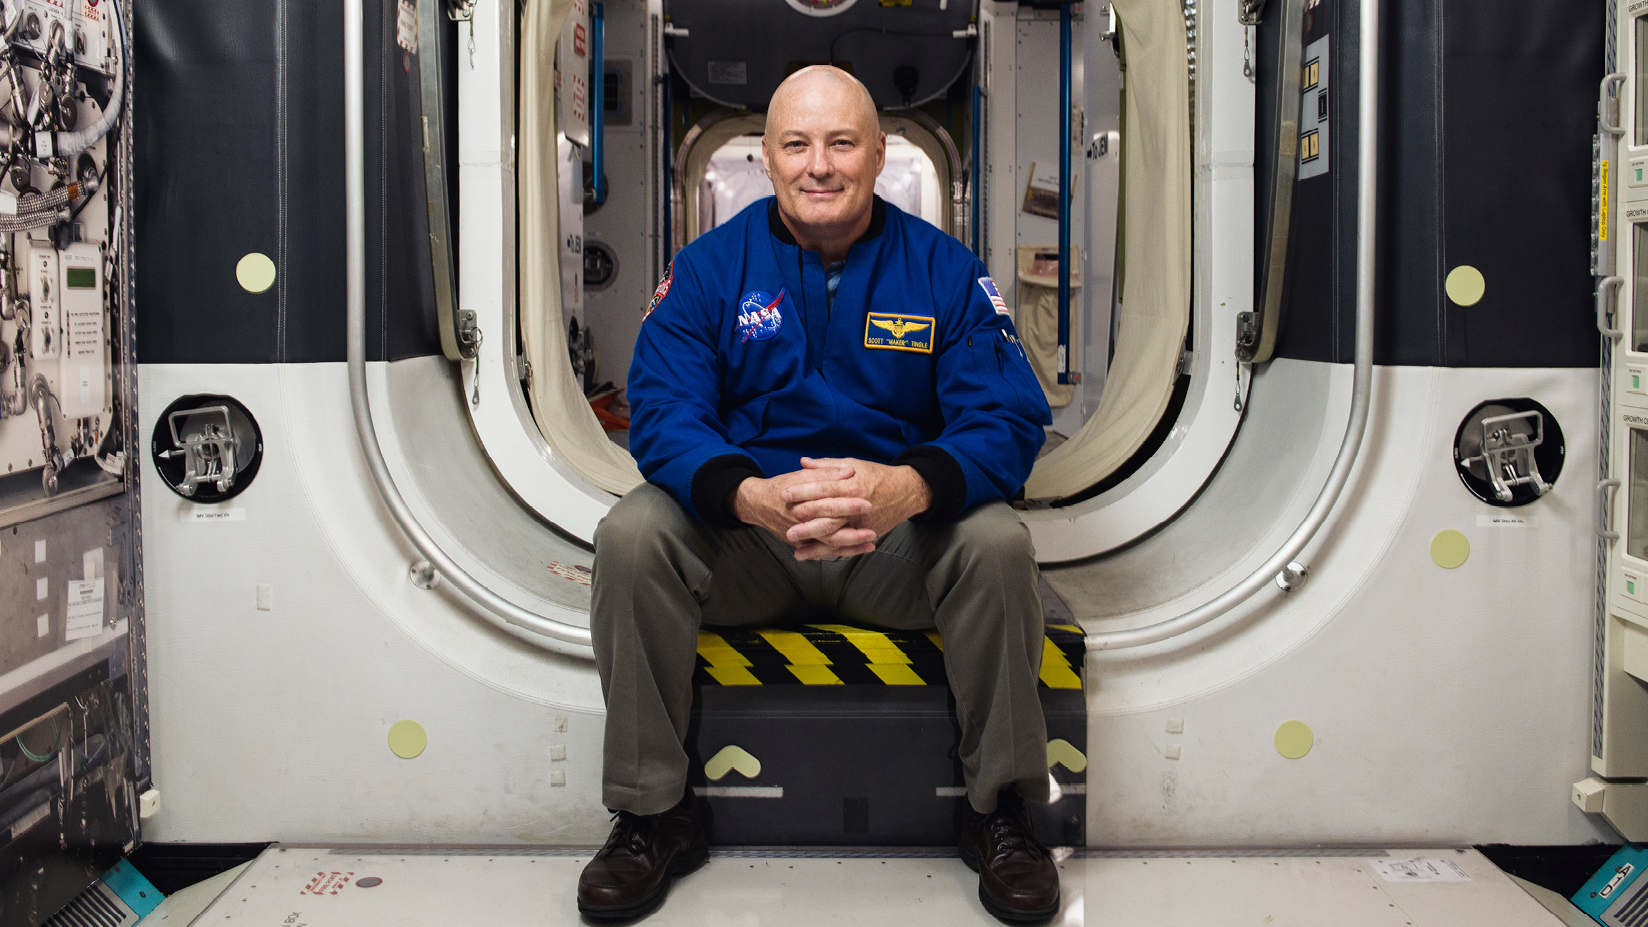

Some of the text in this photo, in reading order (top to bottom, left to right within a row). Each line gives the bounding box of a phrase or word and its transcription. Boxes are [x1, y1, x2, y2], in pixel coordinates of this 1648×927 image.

[1626, 209, 1646, 217] GROWTH
[738, 307, 782, 327] NASA
[868, 337, 884, 345] SCOTT
[911, 340, 929, 349] TINGLE
[1623, 414, 1643, 424] GROWTH
[1600, 865, 1632, 897] ATD
